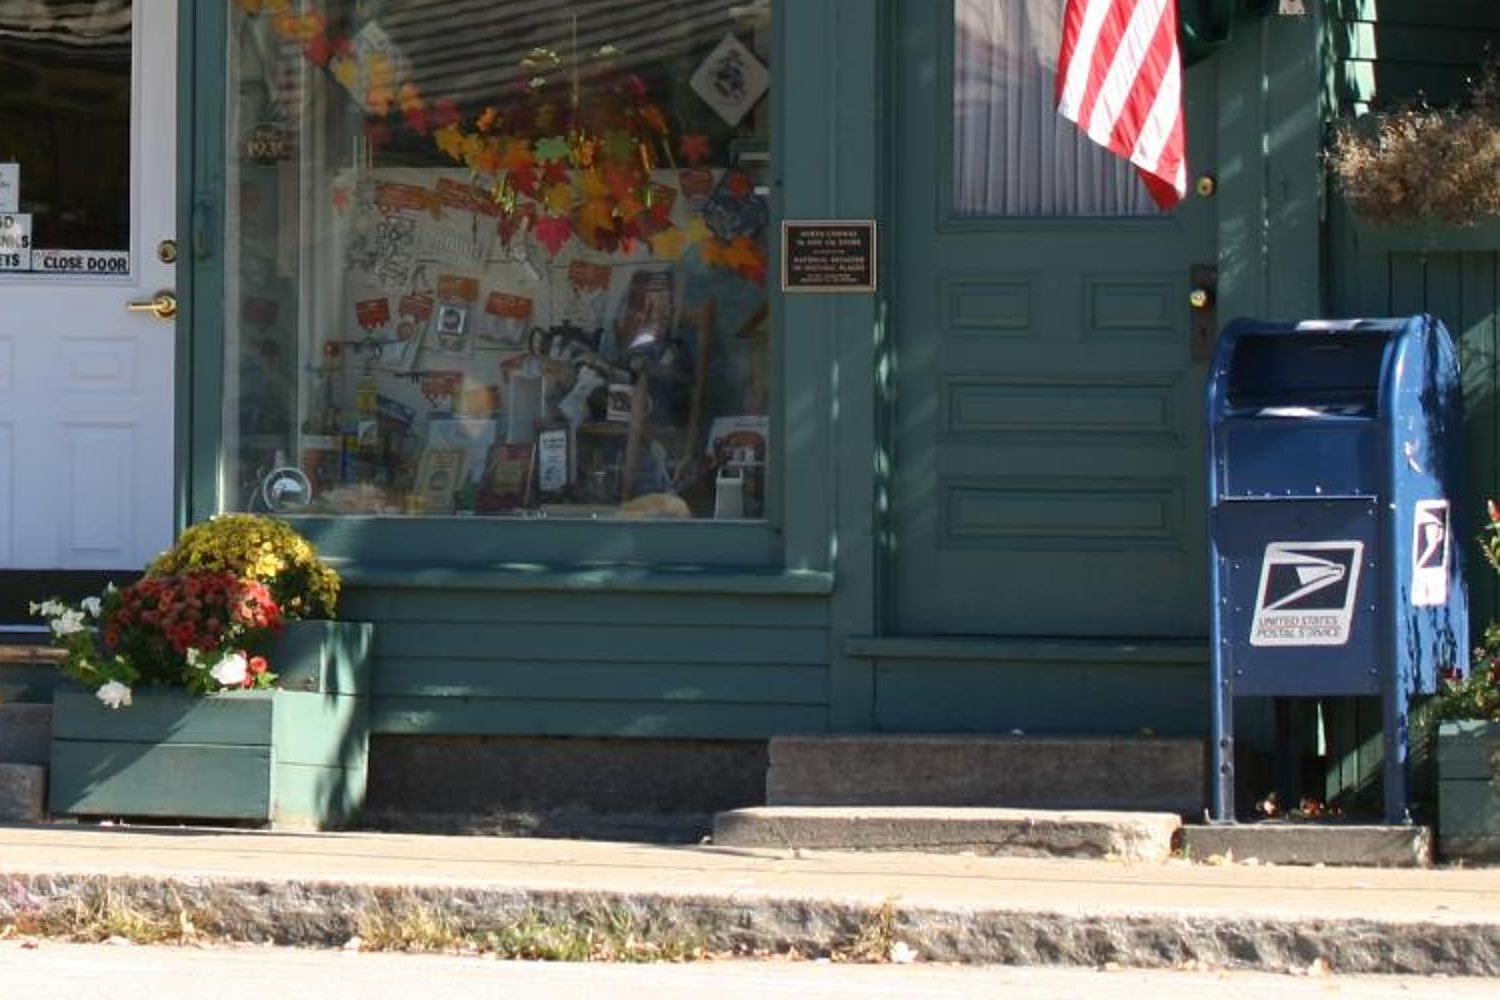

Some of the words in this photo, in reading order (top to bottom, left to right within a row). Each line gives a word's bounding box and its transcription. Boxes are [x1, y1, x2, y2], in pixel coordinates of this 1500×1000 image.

[43, 256, 84, 270] CLOSE
[87, 257, 127, 271] DOOR
[1299, 615, 1338, 626] STATES
